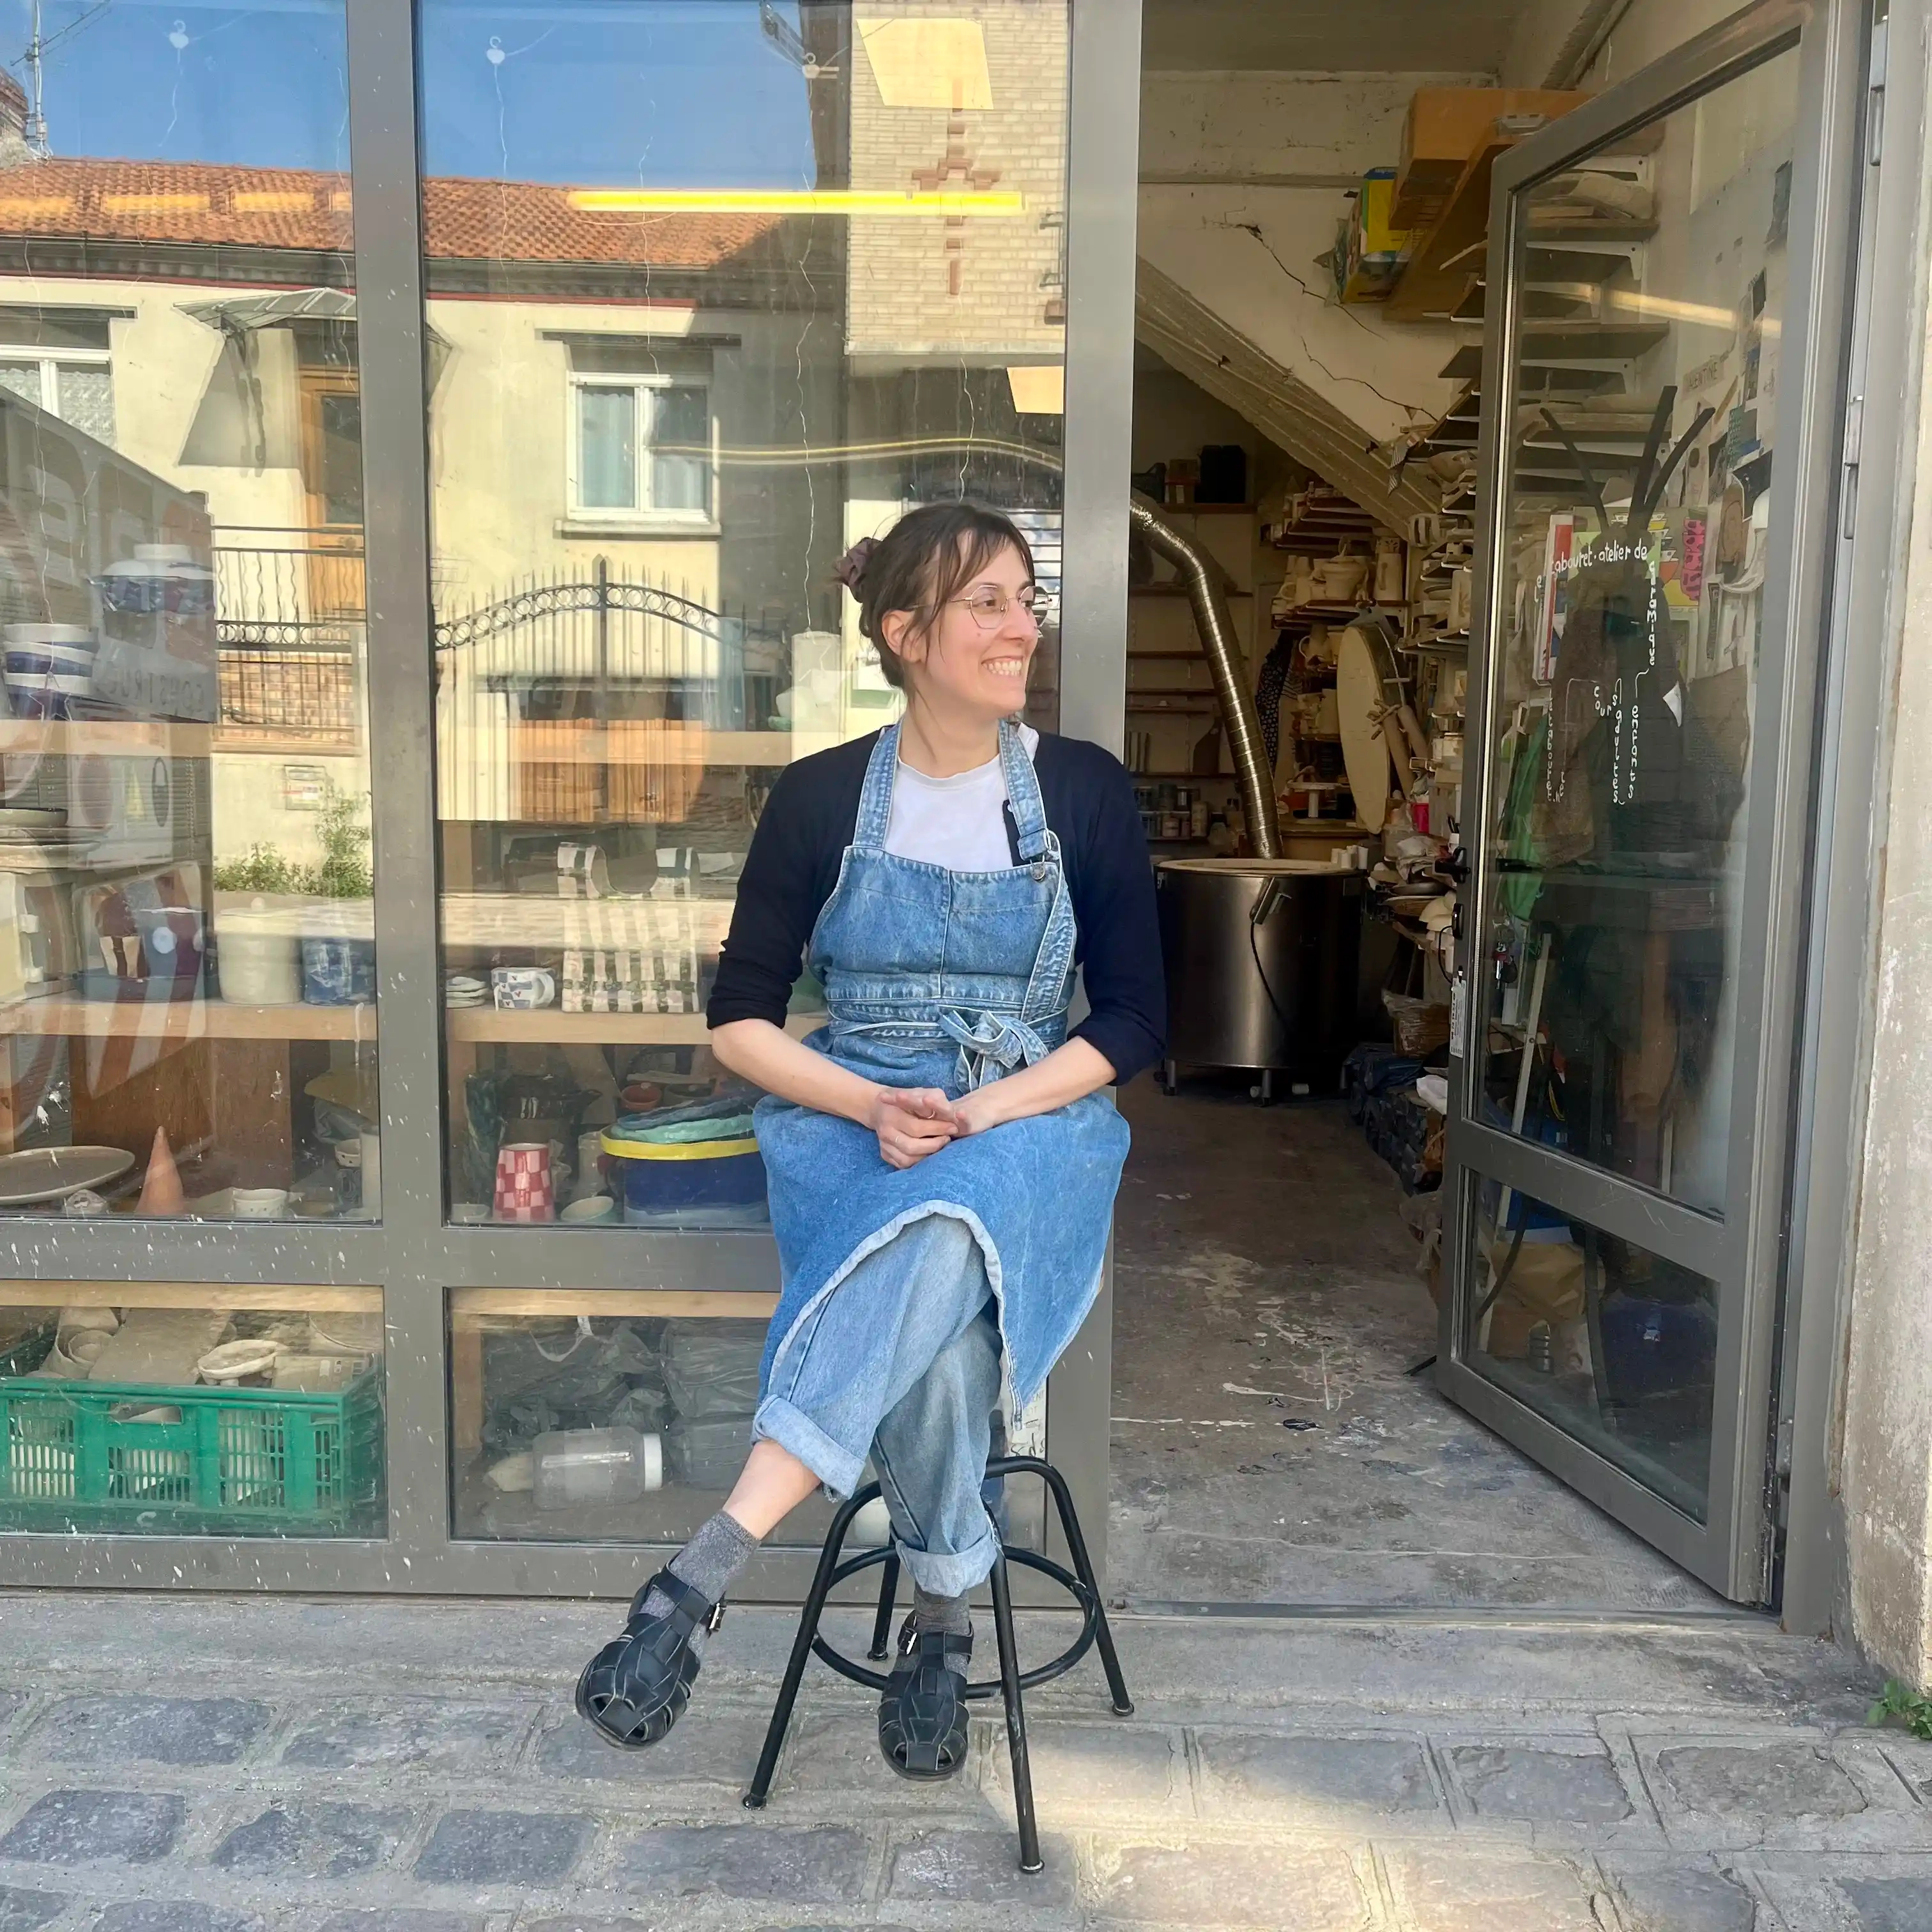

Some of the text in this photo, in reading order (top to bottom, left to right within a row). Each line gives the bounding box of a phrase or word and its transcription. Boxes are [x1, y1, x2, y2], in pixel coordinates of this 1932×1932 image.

[1598, 539, 1630, 562] atelier
[1634, 538, 1648, 560] de
[1593, 686, 1618, 717] cours
[1613, 710, 1623, 803] adultes
[1628, 705, 1639, 799] enfants
